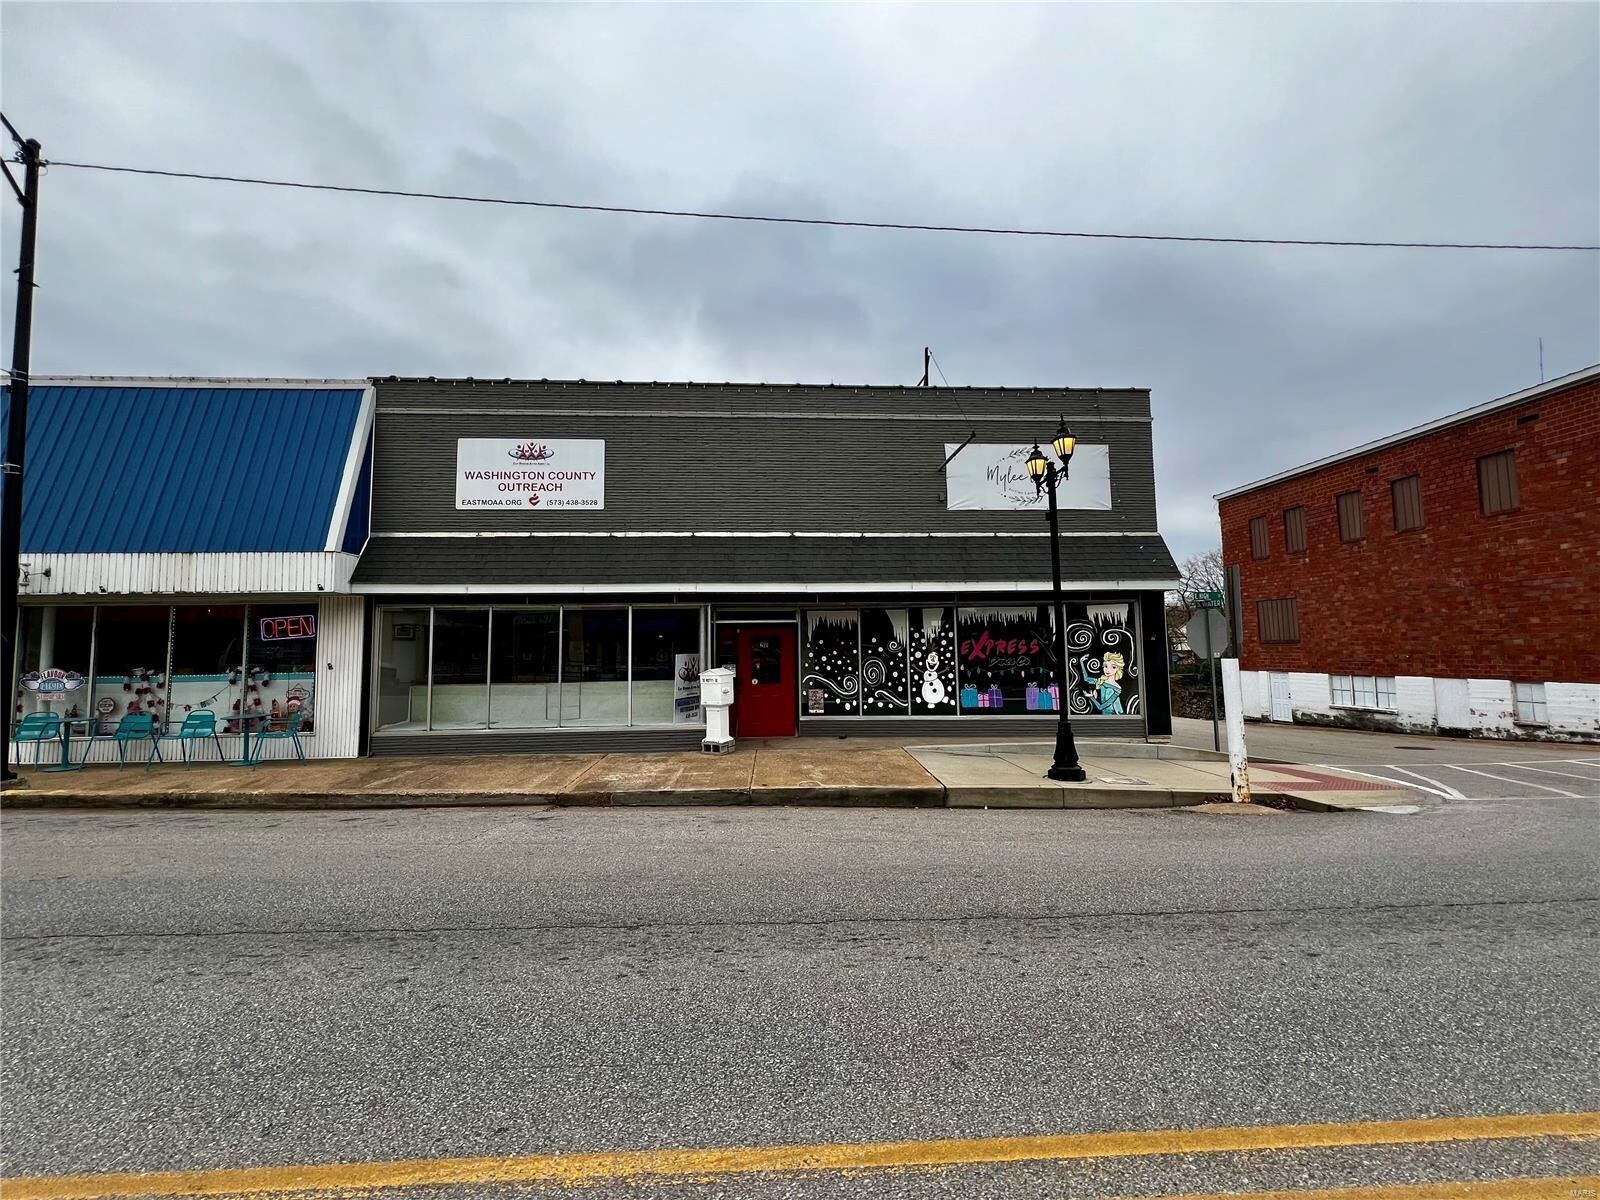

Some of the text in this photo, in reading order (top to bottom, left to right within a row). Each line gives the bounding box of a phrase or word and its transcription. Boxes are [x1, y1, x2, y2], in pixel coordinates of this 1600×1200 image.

[464, 471, 596, 480] WASHINGTON COUNTY
[498, 483, 563, 492] OUTREACH
[546, 499, 565, 507] (573)
[262, 616, 313, 638] OPEN
[960, 630, 1040, 661] EXPRESS
